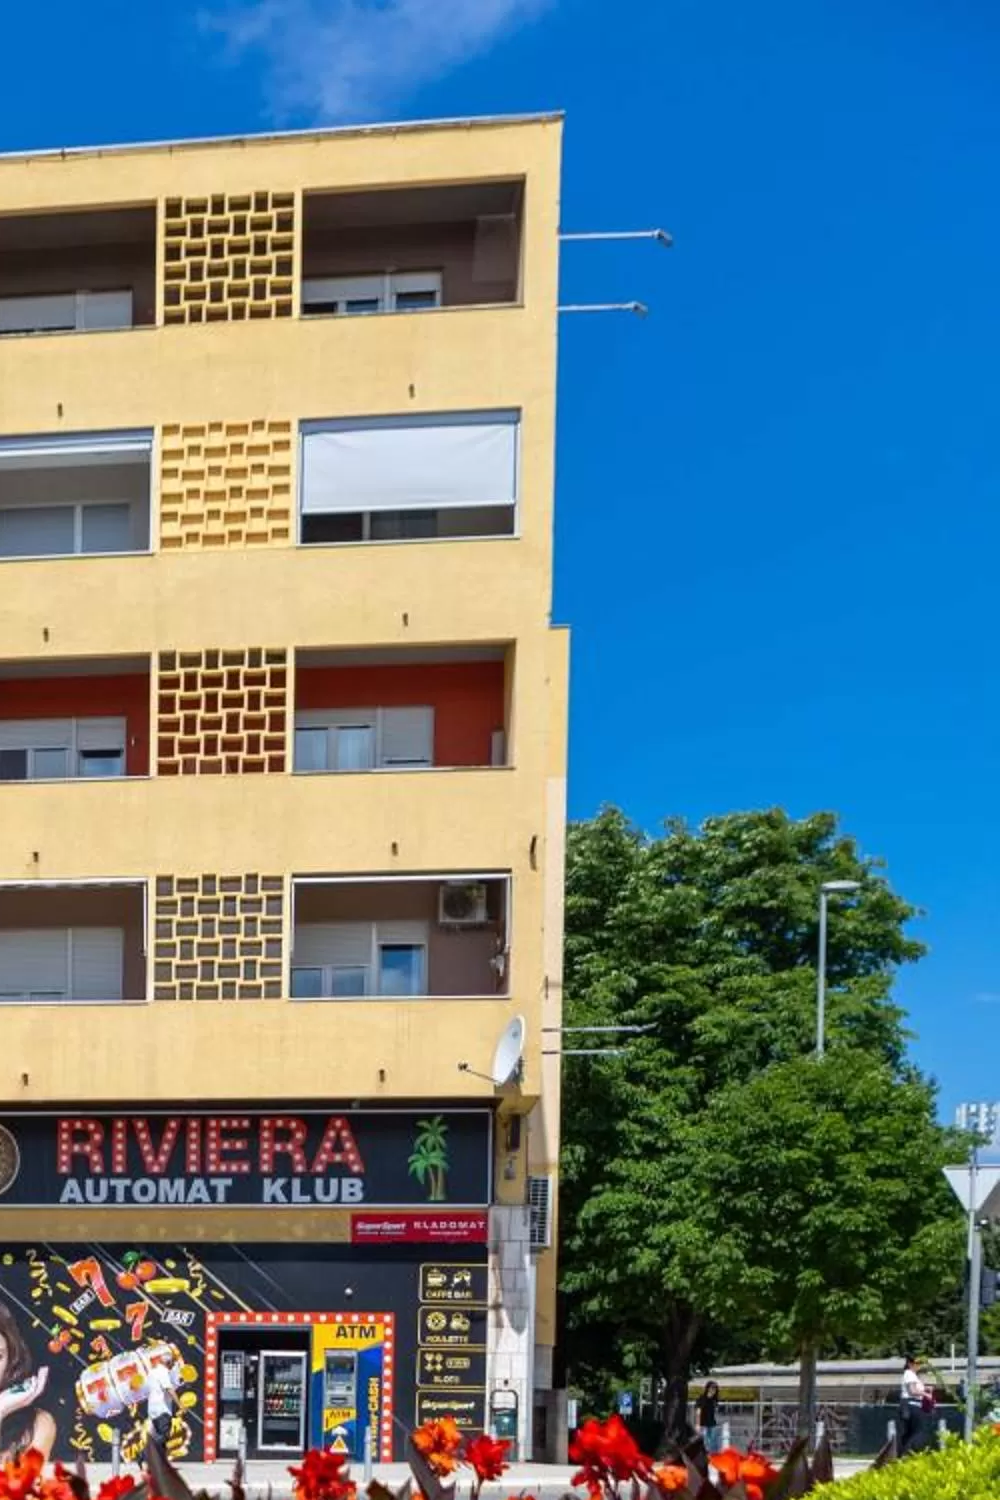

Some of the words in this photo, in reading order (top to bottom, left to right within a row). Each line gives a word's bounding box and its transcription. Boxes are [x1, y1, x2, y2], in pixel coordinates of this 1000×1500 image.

[57, 1117, 365, 1173] RIVIERA
[59, 1178, 233, 1203] AUTOMAT
[262, 1178, 365, 1203] KLUB
[356, 1221, 406, 1232] SuperSport
[412, 1221, 485, 1229] KLADOMAT
[335, 1325, 376, 1338] ATM
[425, 1334, 468, 1344] ROULETTE
[433, 1375, 460, 1384] SLOTS
[367, 1377, 379, 1411] CASH
[328, 1410, 351, 1419] ATM
